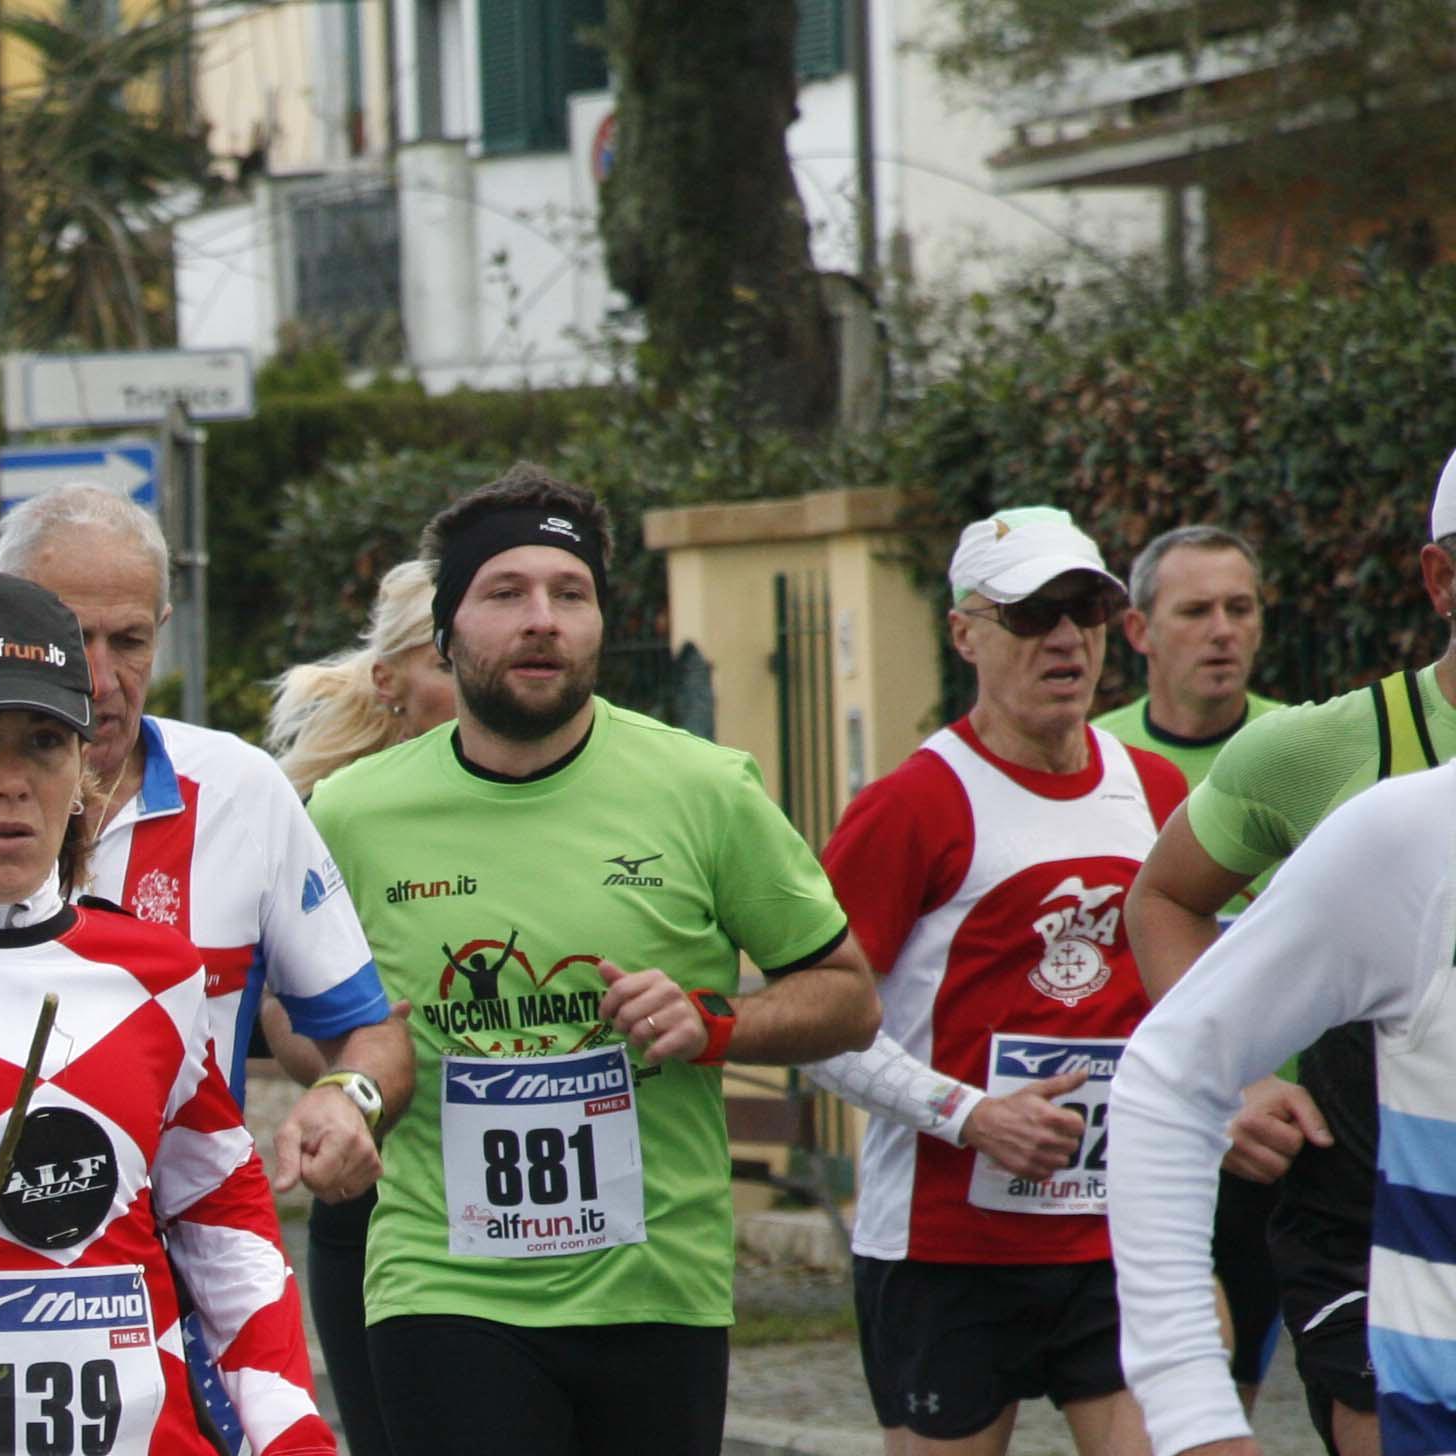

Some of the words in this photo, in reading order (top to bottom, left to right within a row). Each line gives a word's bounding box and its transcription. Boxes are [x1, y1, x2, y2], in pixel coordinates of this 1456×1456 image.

[386, 875, 477, 904] alfrun.it
[517, 990, 600, 1028] MARAT
[589, 1100, 626, 1113] TIMEX
[2, 1154, 107, 1194] ALF
[483, 1124, 598, 1207] 881
[22, 1178, 90, 1203] RUN
[487, 1208, 606, 1239] alfrun.it
[527, 1241, 557, 1252] corri
[560, 1239, 584, 1250] con
[112, 1331, 146, 1344] TIMEX
